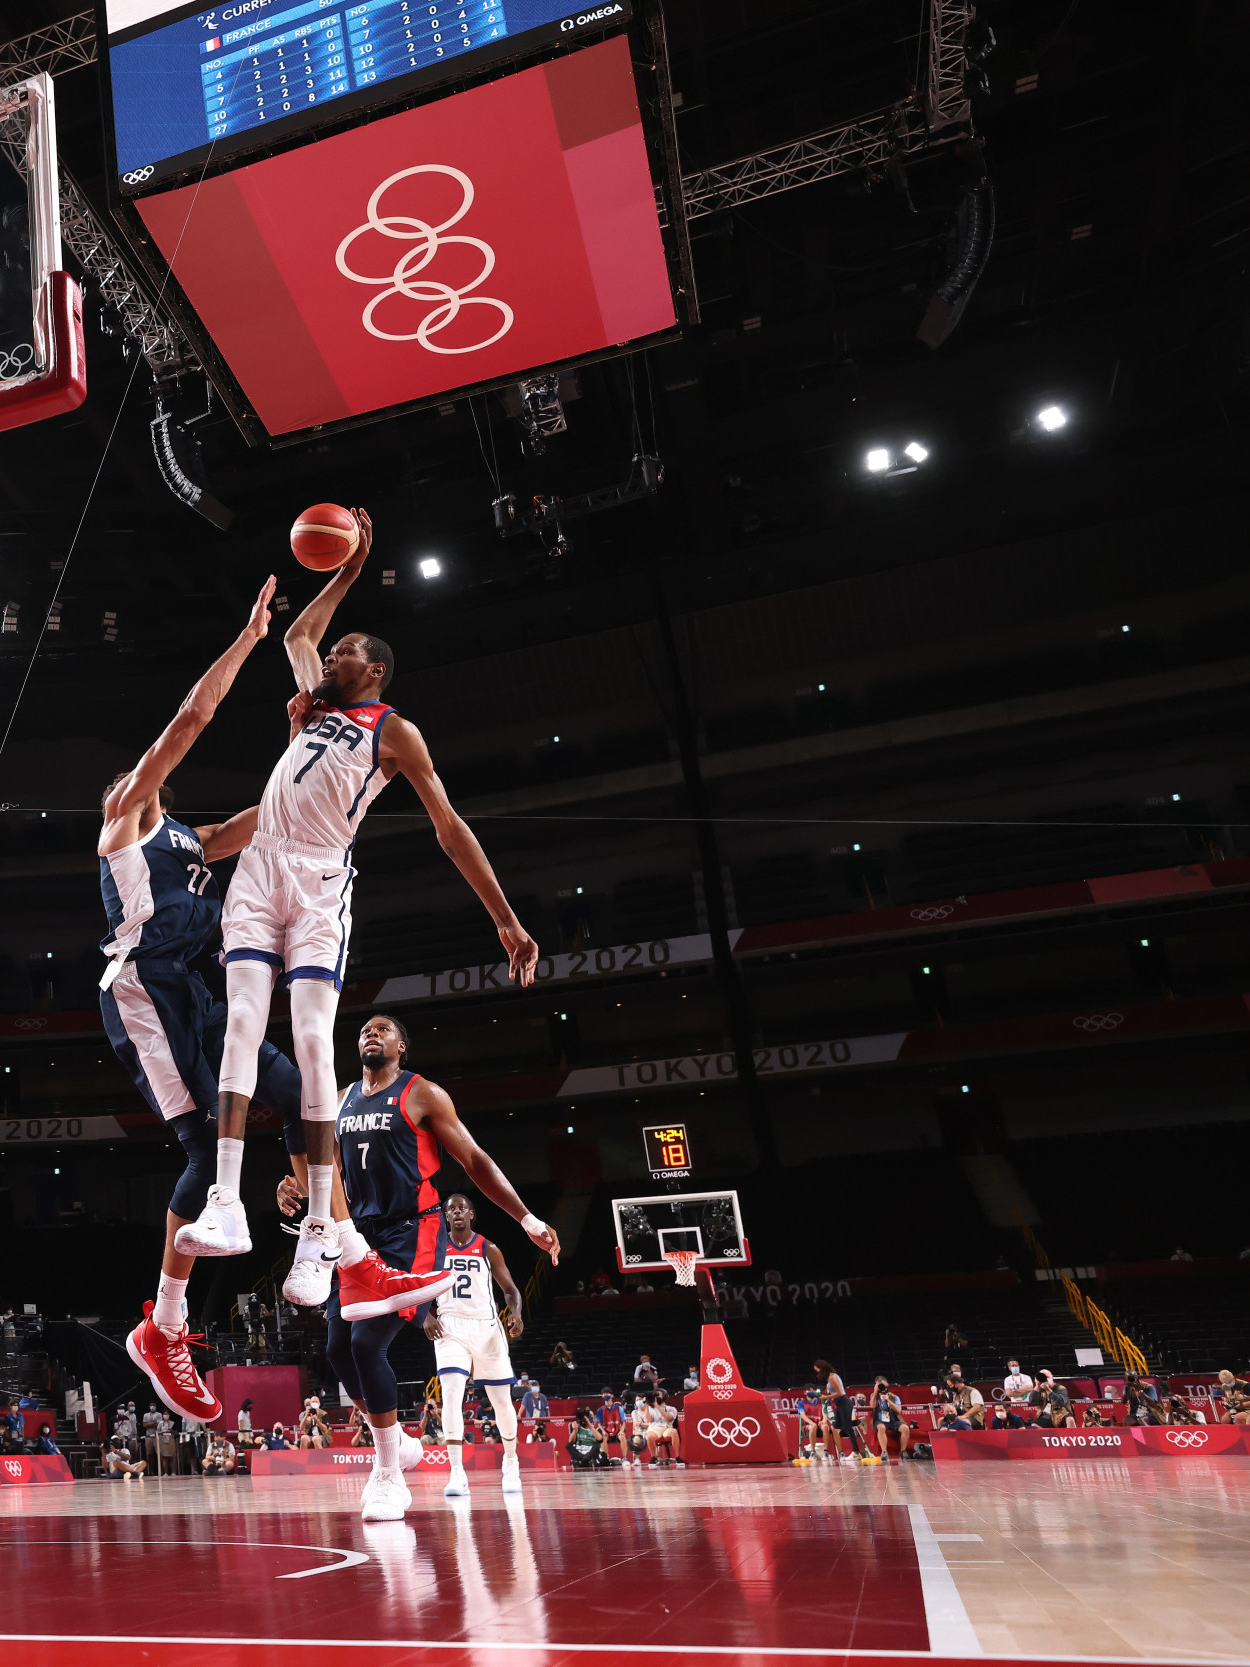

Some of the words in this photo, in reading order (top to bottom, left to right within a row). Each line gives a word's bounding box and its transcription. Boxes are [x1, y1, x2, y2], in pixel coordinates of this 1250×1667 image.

[222, 0, 278, 20] CURRE
[351, 6, 370, 17] NO.
[362, 17, 368, 25] 6
[401, 2, 408, 11] 2
[363, 30, 370, 39] 7
[403, 16, 410, 24] 2
[429, 6, 436, 14] 0
[577, 4, 623, 25] OMEGA
[206, 60, 225, 71] NO.
[249, 45, 260, 55] PF
[272, 36, 286, 47] AS
[294, 26, 312, 37] RBS
[320, 17, 337, 28] PTS
[226, 20, 272, 43] FRANCE
[359, 44, 373, 55] 10
[406, 30, 412, 38] 1
[431, 20, 439, 28] 0
[458, 10, 466, 19] 4
[483, 0, 496, 10] 11
[361, 58, 375, 69] 12
[408, 43, 415, 52] 2
[434, 34, 441, 42] 0
[461, 24, 468, 32] 3
[488, 14, 495, 23] 6
[216, 71, 223, 79] 4
[253, 58, 259, 66] 1
[277, 49, 284, 57] 1
[302, 39, 308, 48] 1
[326, 29, 333, 38] 0
[217, 84, 223, 92] 5
[254, 71, 261, 79] 2
[279, 62, 285, 70] 1
[304, 53, 310, 61] 1
[328, 43, 335, 51] 0
[363, 72, 376, 83] 13
[410, 58, 417, 66] 1
[436, 48, 443, 56] 3
[463, 38, 470, 47] 5
[491, 28, 498, 37] 4
[214, 111, 226, 121] 10
[257, 98, 264, 106] 2
[282, 89, 288, 97] 2
[307, 80, 313, 88] 3
[329, 70, 342, 80] 11
[218, 97, 225, 106] 7
[256, 84, 262, 92] 1
[280, 75, 287, 83] 2
[305, 66, 312, 74] 3
[327, 56, 340, 67] 10
[215, 125, 228, 136] 27
[259, 112, 265, 120] 1
[283, 102, 290, 110] 0
[309, 94, 315, 102] 8
[331, 83, 345, 95] 14
[302, 716, 364, 752] USA
[293, 741, 328, 784] 7
[187, 863, 212, 896] 27
[423, 956, 555, 996] TOKO
[568, 940, 670, 976] 2020
[612, 1053, 736, 1087] TOKYO
[756, 1040, 852, 1073] 2020
[5, 1119, 82, 1140] 2020
[339, 1112, 393, 1136] FRANCE
[654, 1129, 684, 1142] 4:24
[357, 1142, 370, 1170] 7
[662, 1144, 685, 1166] 18
[661, 1170, 689, 1178] OMEGA
[1042, 1436, 1086, 1447] TOKYO
[1090, 1435, 1121, 1446] 2020
[333, 1454, 364, 1464] TOKYO
[366, 1454, 377, 1463] 20
